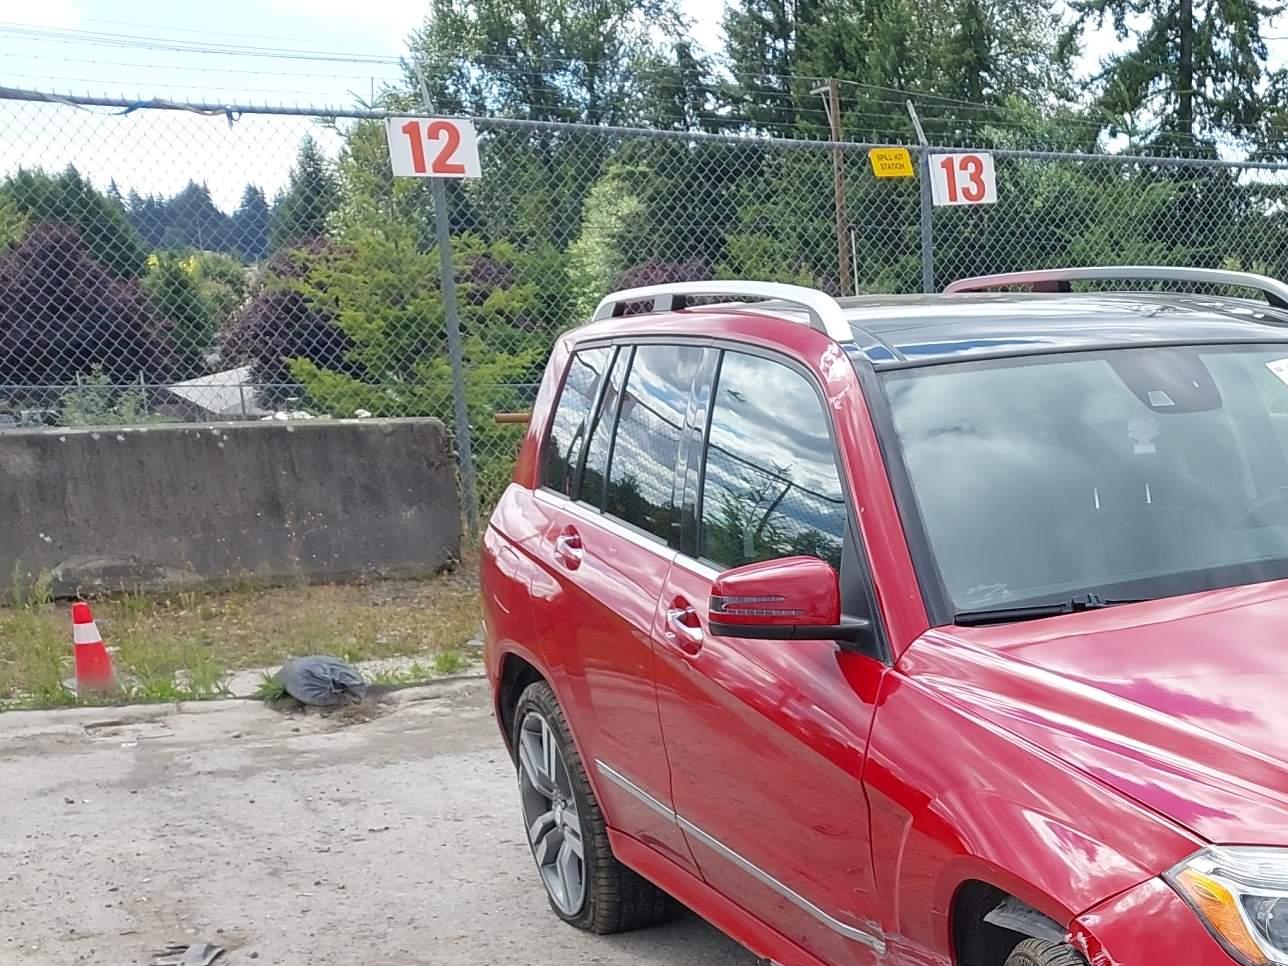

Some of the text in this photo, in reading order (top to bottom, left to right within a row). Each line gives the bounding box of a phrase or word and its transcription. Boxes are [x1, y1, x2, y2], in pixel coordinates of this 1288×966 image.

[402, 121, 465, 174] 12
[876, 153, 892, 161] SPILL
[880, 162, 905, 170] STATION
[941, 155, 985, 202] 13
